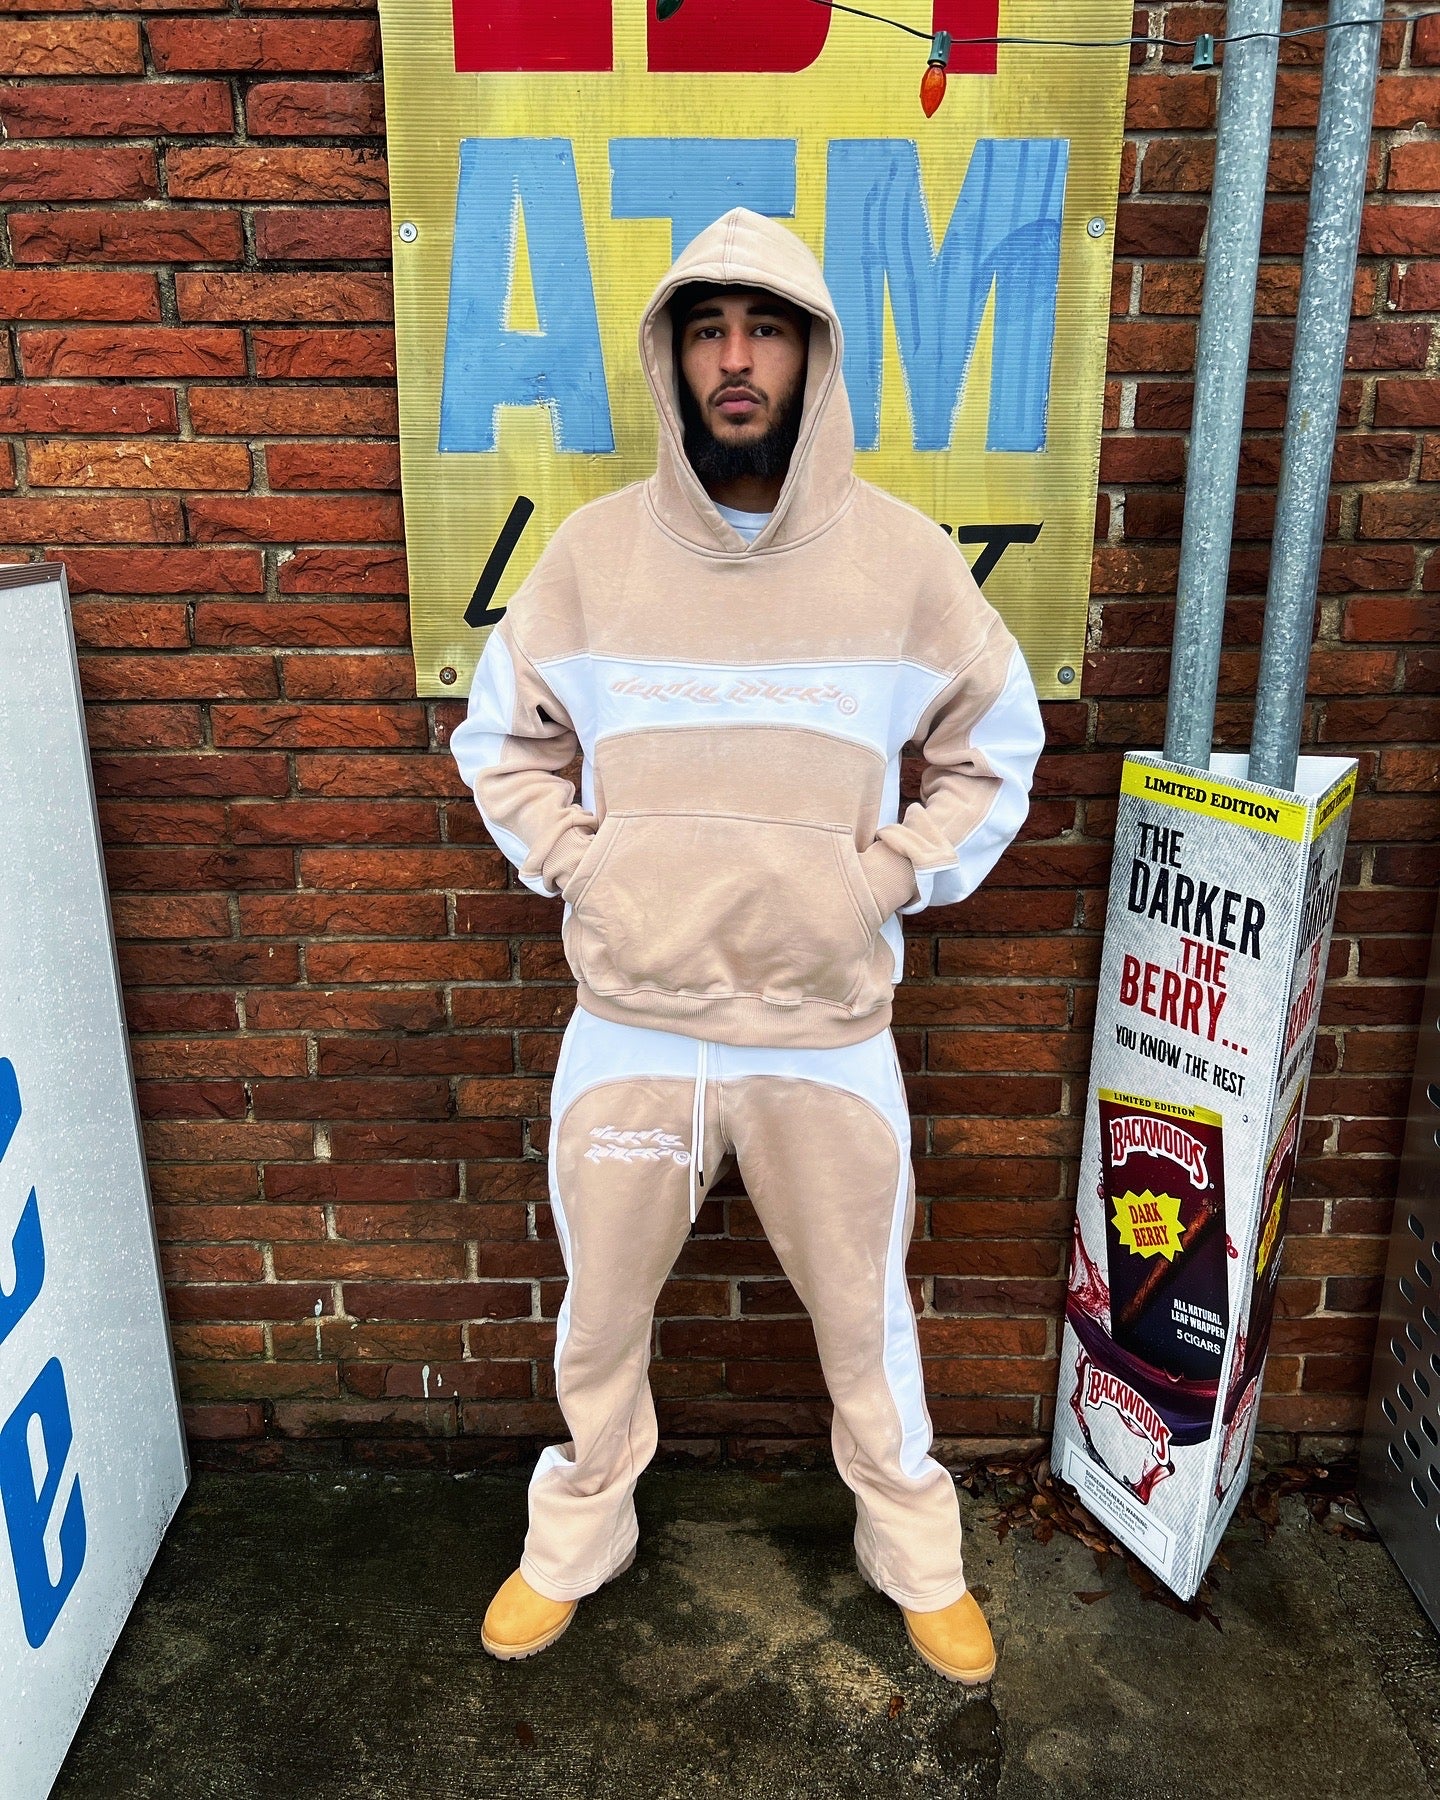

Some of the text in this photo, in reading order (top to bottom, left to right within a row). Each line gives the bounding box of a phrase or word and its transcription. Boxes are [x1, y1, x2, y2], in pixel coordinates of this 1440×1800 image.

[437, 137, 1071, 455] ATM
[1144, 775, 1207, 803] LIMITED
[1210, 792, 1280, 823] EDITION
[1137, 821, 1184, 869] THE
[1127, 858, 1266, 960] DARKER
[1180, 936, 1229, 989] THE
[1119, 953, 1249, 1055] BERRY...
[1115, 1023, 1246, 1097] YOU KNOW THE REST
[1113, 1092, 1196, 1117] LIMITED EDITION
[1110, 1117, 1207, 1187] BACKWOODS
[1128, 1202, 1163, 1224] DARK
[1132, 1225, 1170, 1247] BERRY
[1171, 1309, 1226, 1339] LEAF WRAPPER
[1173, 1298, 1222, 1325] ALL NATURAL
[1176, 1328, 1221, 1355] 5 CIGARS
[1087, 1368, 1171, 1463] BACKWOODS
